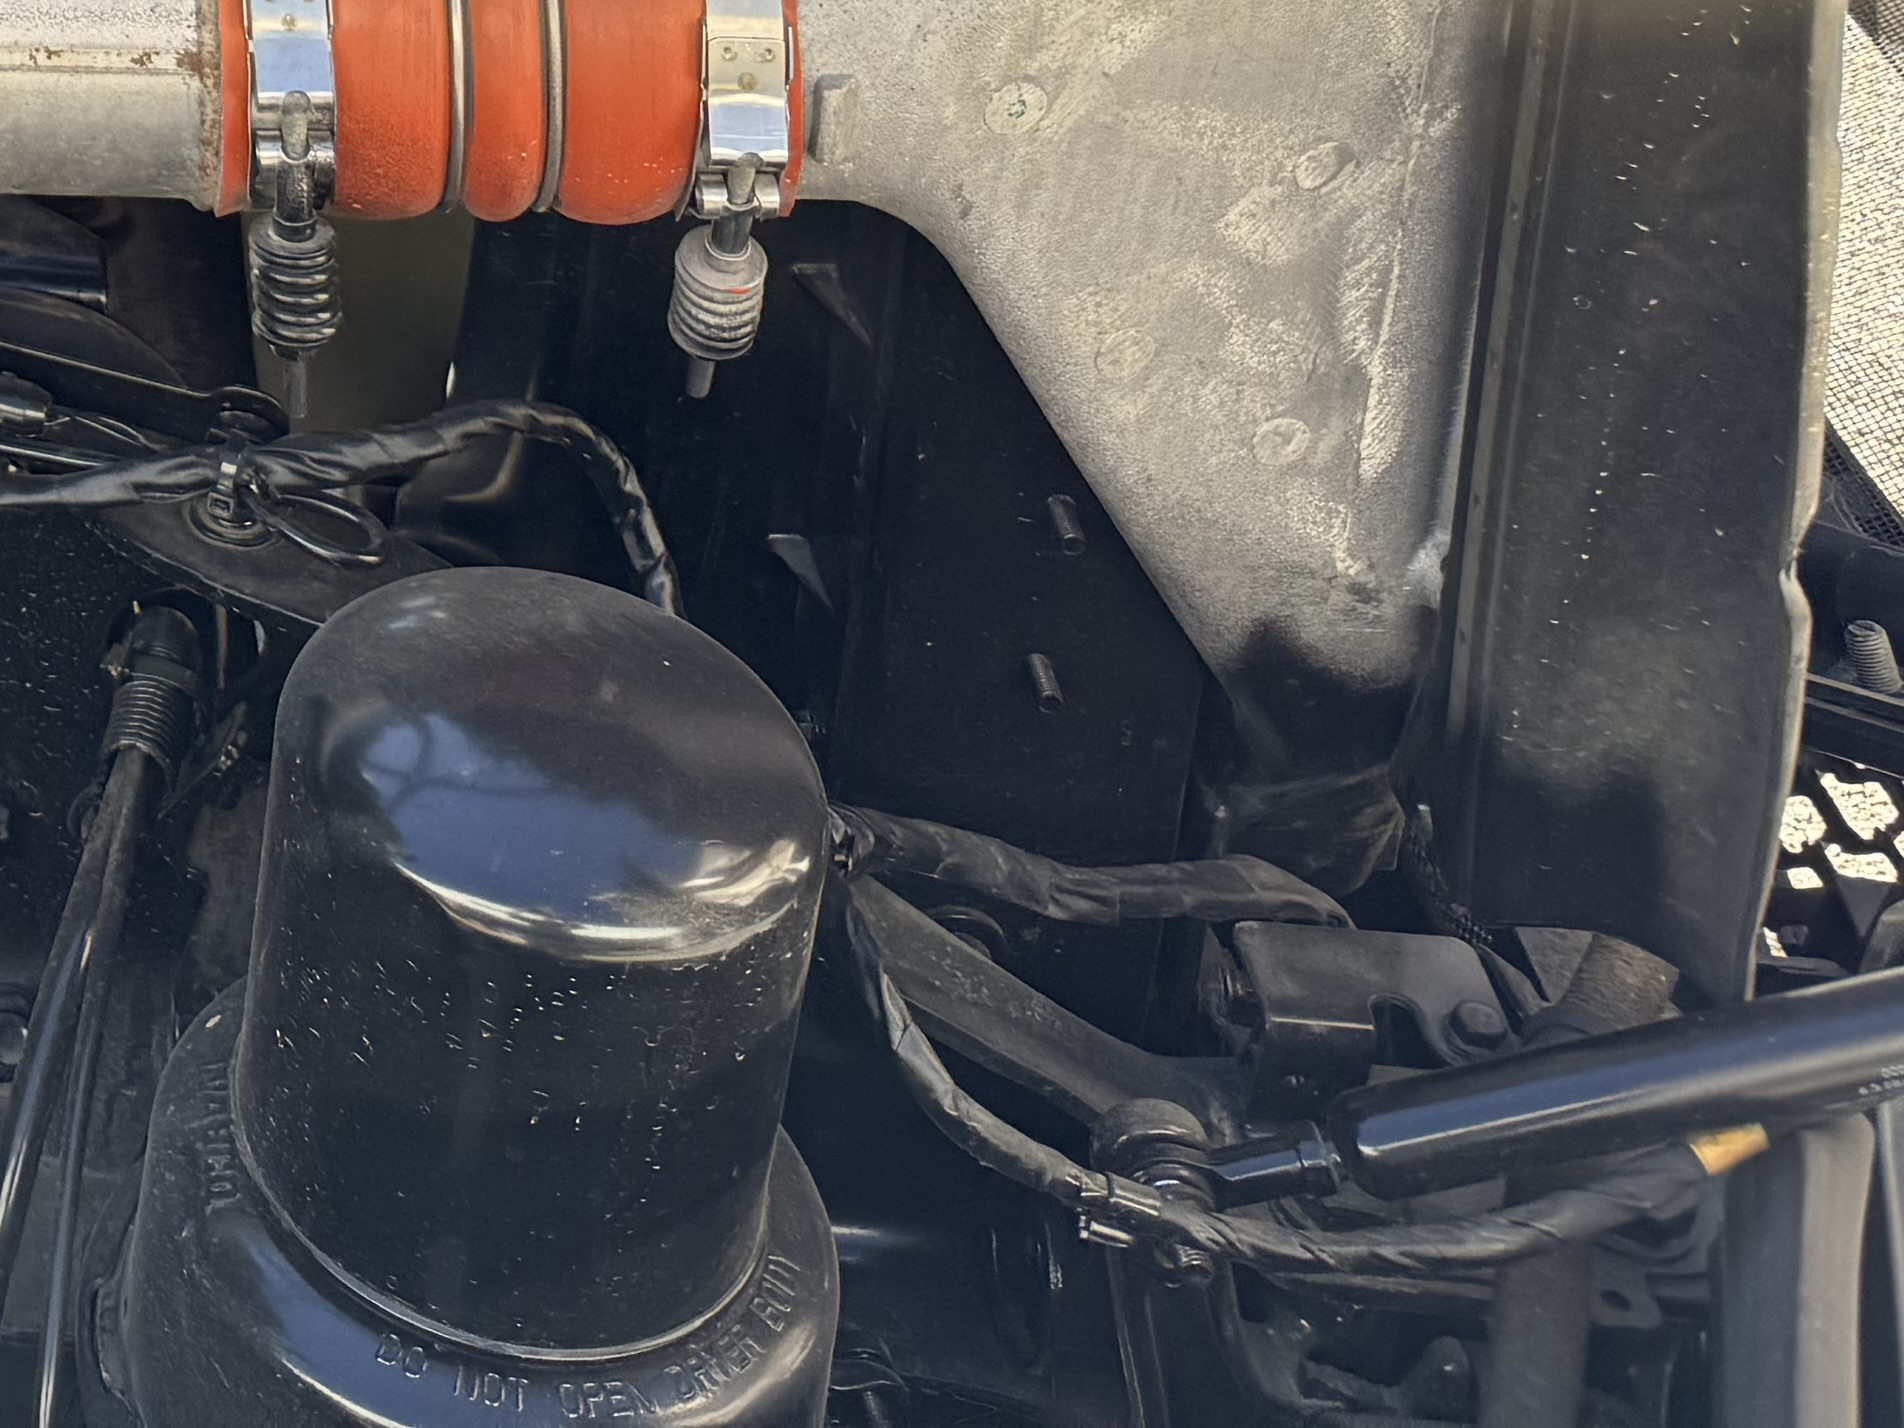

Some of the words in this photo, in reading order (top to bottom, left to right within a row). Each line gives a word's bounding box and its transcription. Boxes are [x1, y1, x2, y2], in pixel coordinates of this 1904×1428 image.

[372, 1332, 429, 1379] DO
[452, 1363, 531, 1412] NOT
[558, 1380, 662, 1419] OPEN
